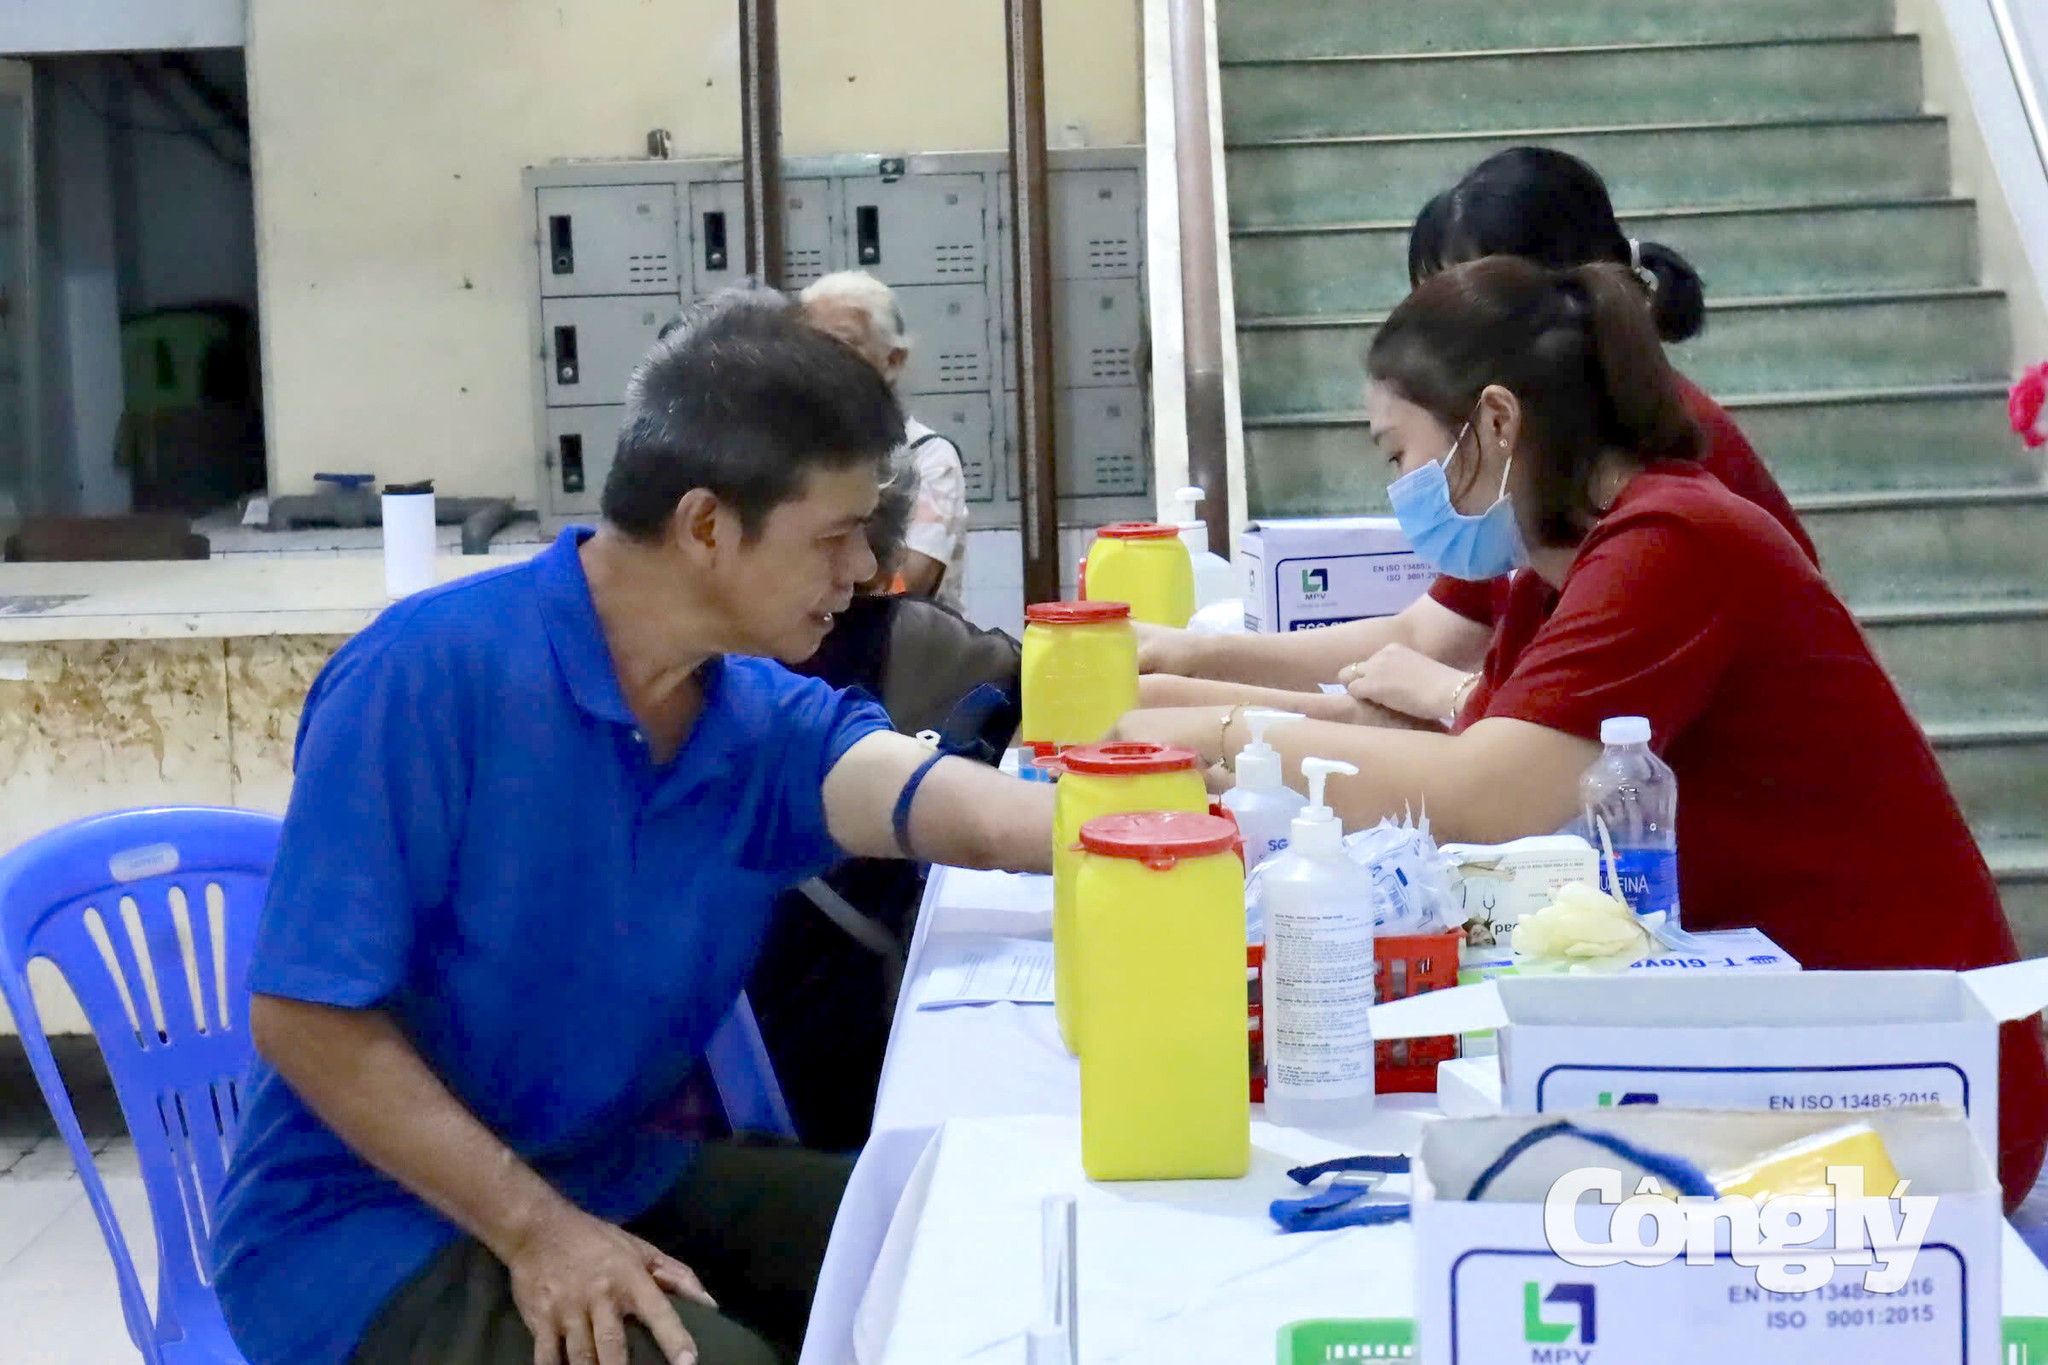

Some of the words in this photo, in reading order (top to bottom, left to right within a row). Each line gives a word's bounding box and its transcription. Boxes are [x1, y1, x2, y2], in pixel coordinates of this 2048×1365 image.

[1768, 1095, 1795, 1111] EN
[1800, 1094, 1834, 1110] ISO
[1727, 1284, 1760, 1303] EN
[1766, 1310, 1807, 1330] ISO
[1825, 1303, 1935, 1328] 9001:2015
[1530, 1348, 1591, 1365] MPV
